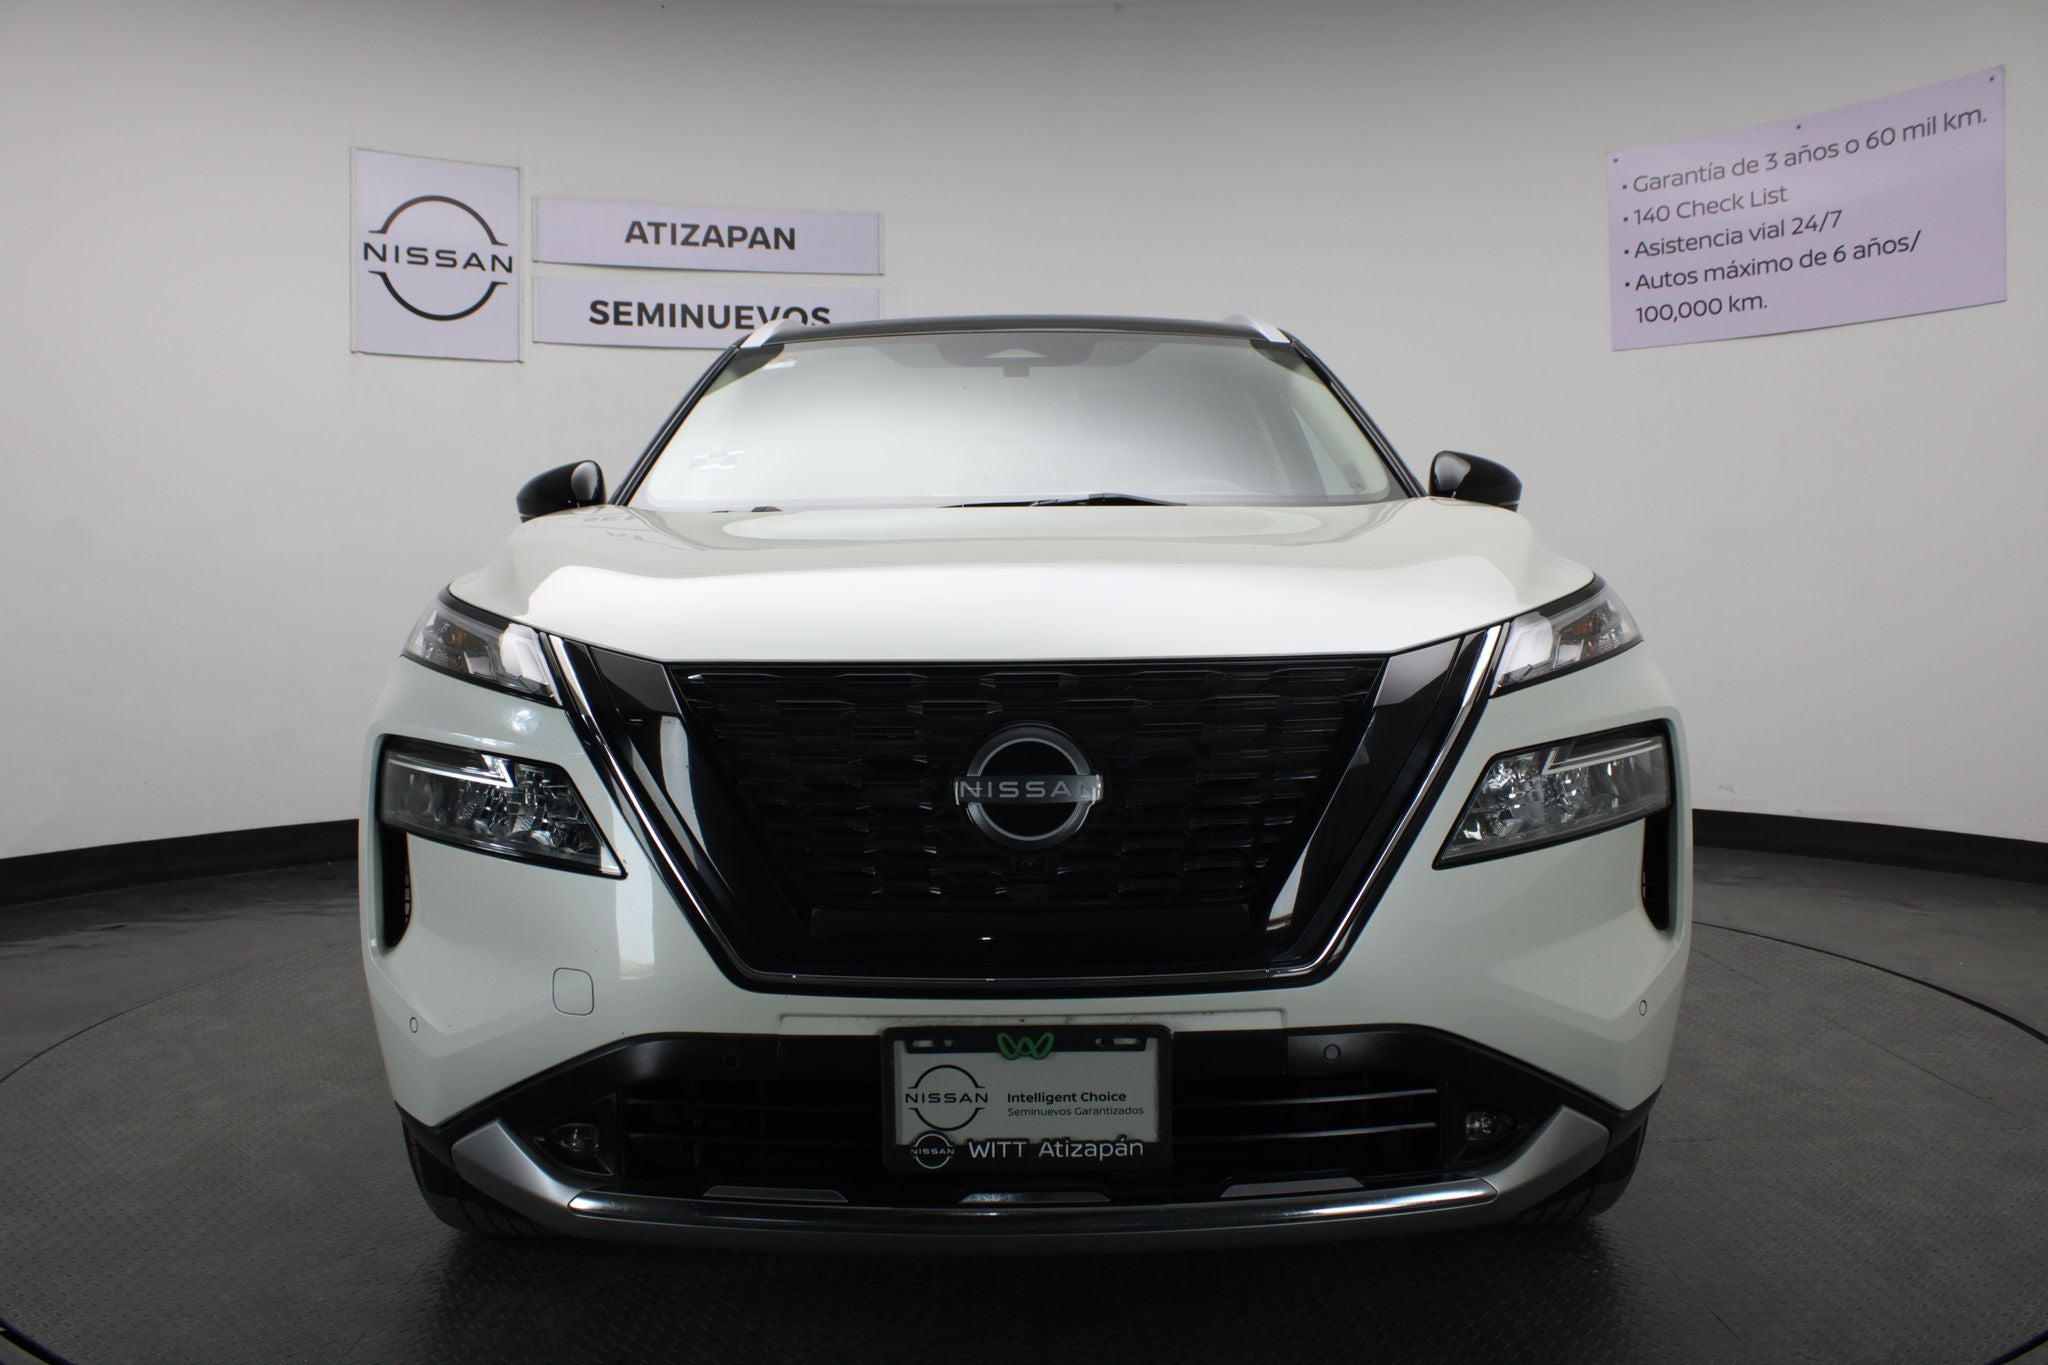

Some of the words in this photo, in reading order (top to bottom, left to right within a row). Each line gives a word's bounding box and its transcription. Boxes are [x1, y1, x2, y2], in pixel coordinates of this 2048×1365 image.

[1633, 161, 1725, 193] Garantía
[1732, 157, 1759, 177] de
[1765, 152, 1778, 171] 3
[1784, 144, 1839, 167] años
[1845, 139, 1859, 155] o
[1866, 127, 1896, 150] 60
[1903, 115, 1936, 140] mil
[1944, 107, 1988, 132] km.
[1634, 204, 1670, 225] 140
[1676, 193, 1744, 219] Check
[1750, 185, 1789, 205] List
[624, 220, 796, 251] ATIZAPAN
[1635, 230, 1743, 258] Asistencia
[1749, 219, 1786, 242] vial
[1792, 209, 1843, 236] 24/7
[363, 242, 513, 274] NISSAN
[1635, 270, 1698, 291] Autos
[1704, 255, 1793, 283] máximo
[1800, 249, 1827, 269] de
[1833, 244, 1846, 263] 6
[1853, 230, 1922, 261] años/
[1635, 298, 1722, 325] 100,000
[1729, 293, 1768, 312] km.
[960, 781, 1096, 799] NISSAN
[905, 1093, 989, 1104] NISSAN
[1007, 1091, 1077, 1105] Intelligent
[1080, 1091, 1127, 1103] Choice
[1007, 1106, 1072, 1117] Seminuevos
[1074, 1105, 1145, 1117] Garantizados
[911, 1147, 955, 1156] NISSAN
[968, 1141, 1028, 1159] WITT
[1038, 1137, 1144, 1161] Atizapán
